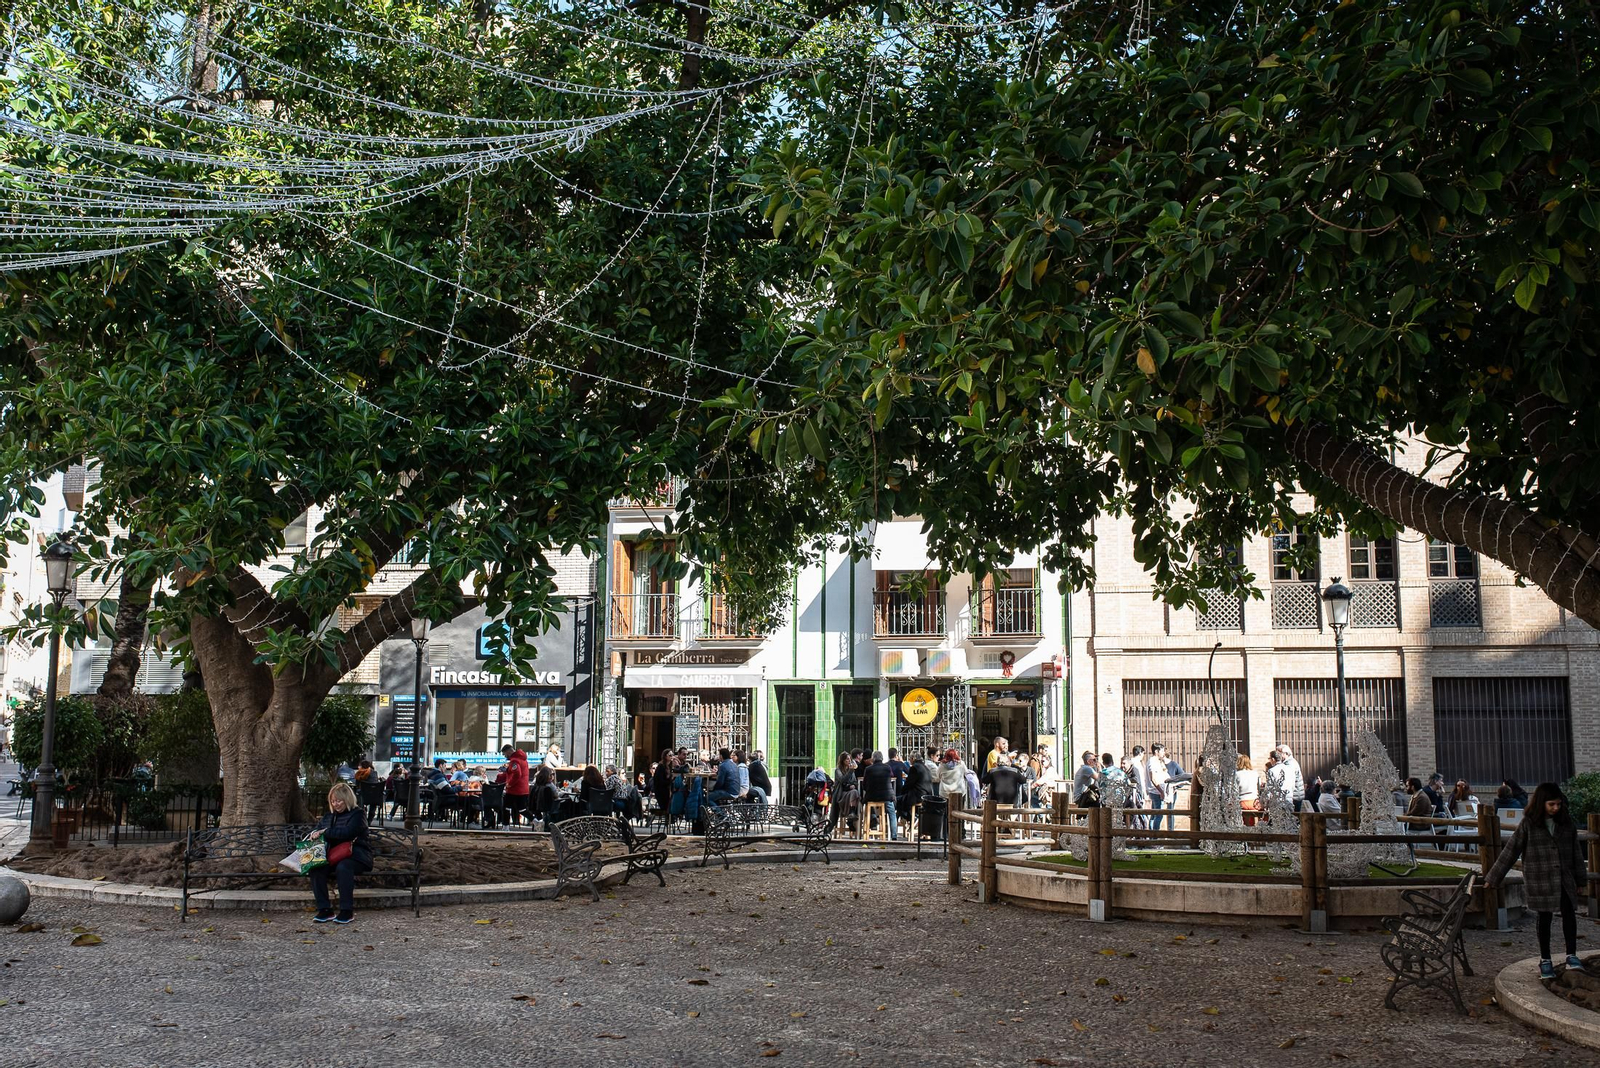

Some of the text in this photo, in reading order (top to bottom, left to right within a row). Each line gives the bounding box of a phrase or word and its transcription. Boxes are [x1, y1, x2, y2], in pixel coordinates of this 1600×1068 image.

[637, 653, 651, 663] La
[655, 652, 715, 664] Gamberra
[651, 674, 736, 687] LA GAMBERRA
